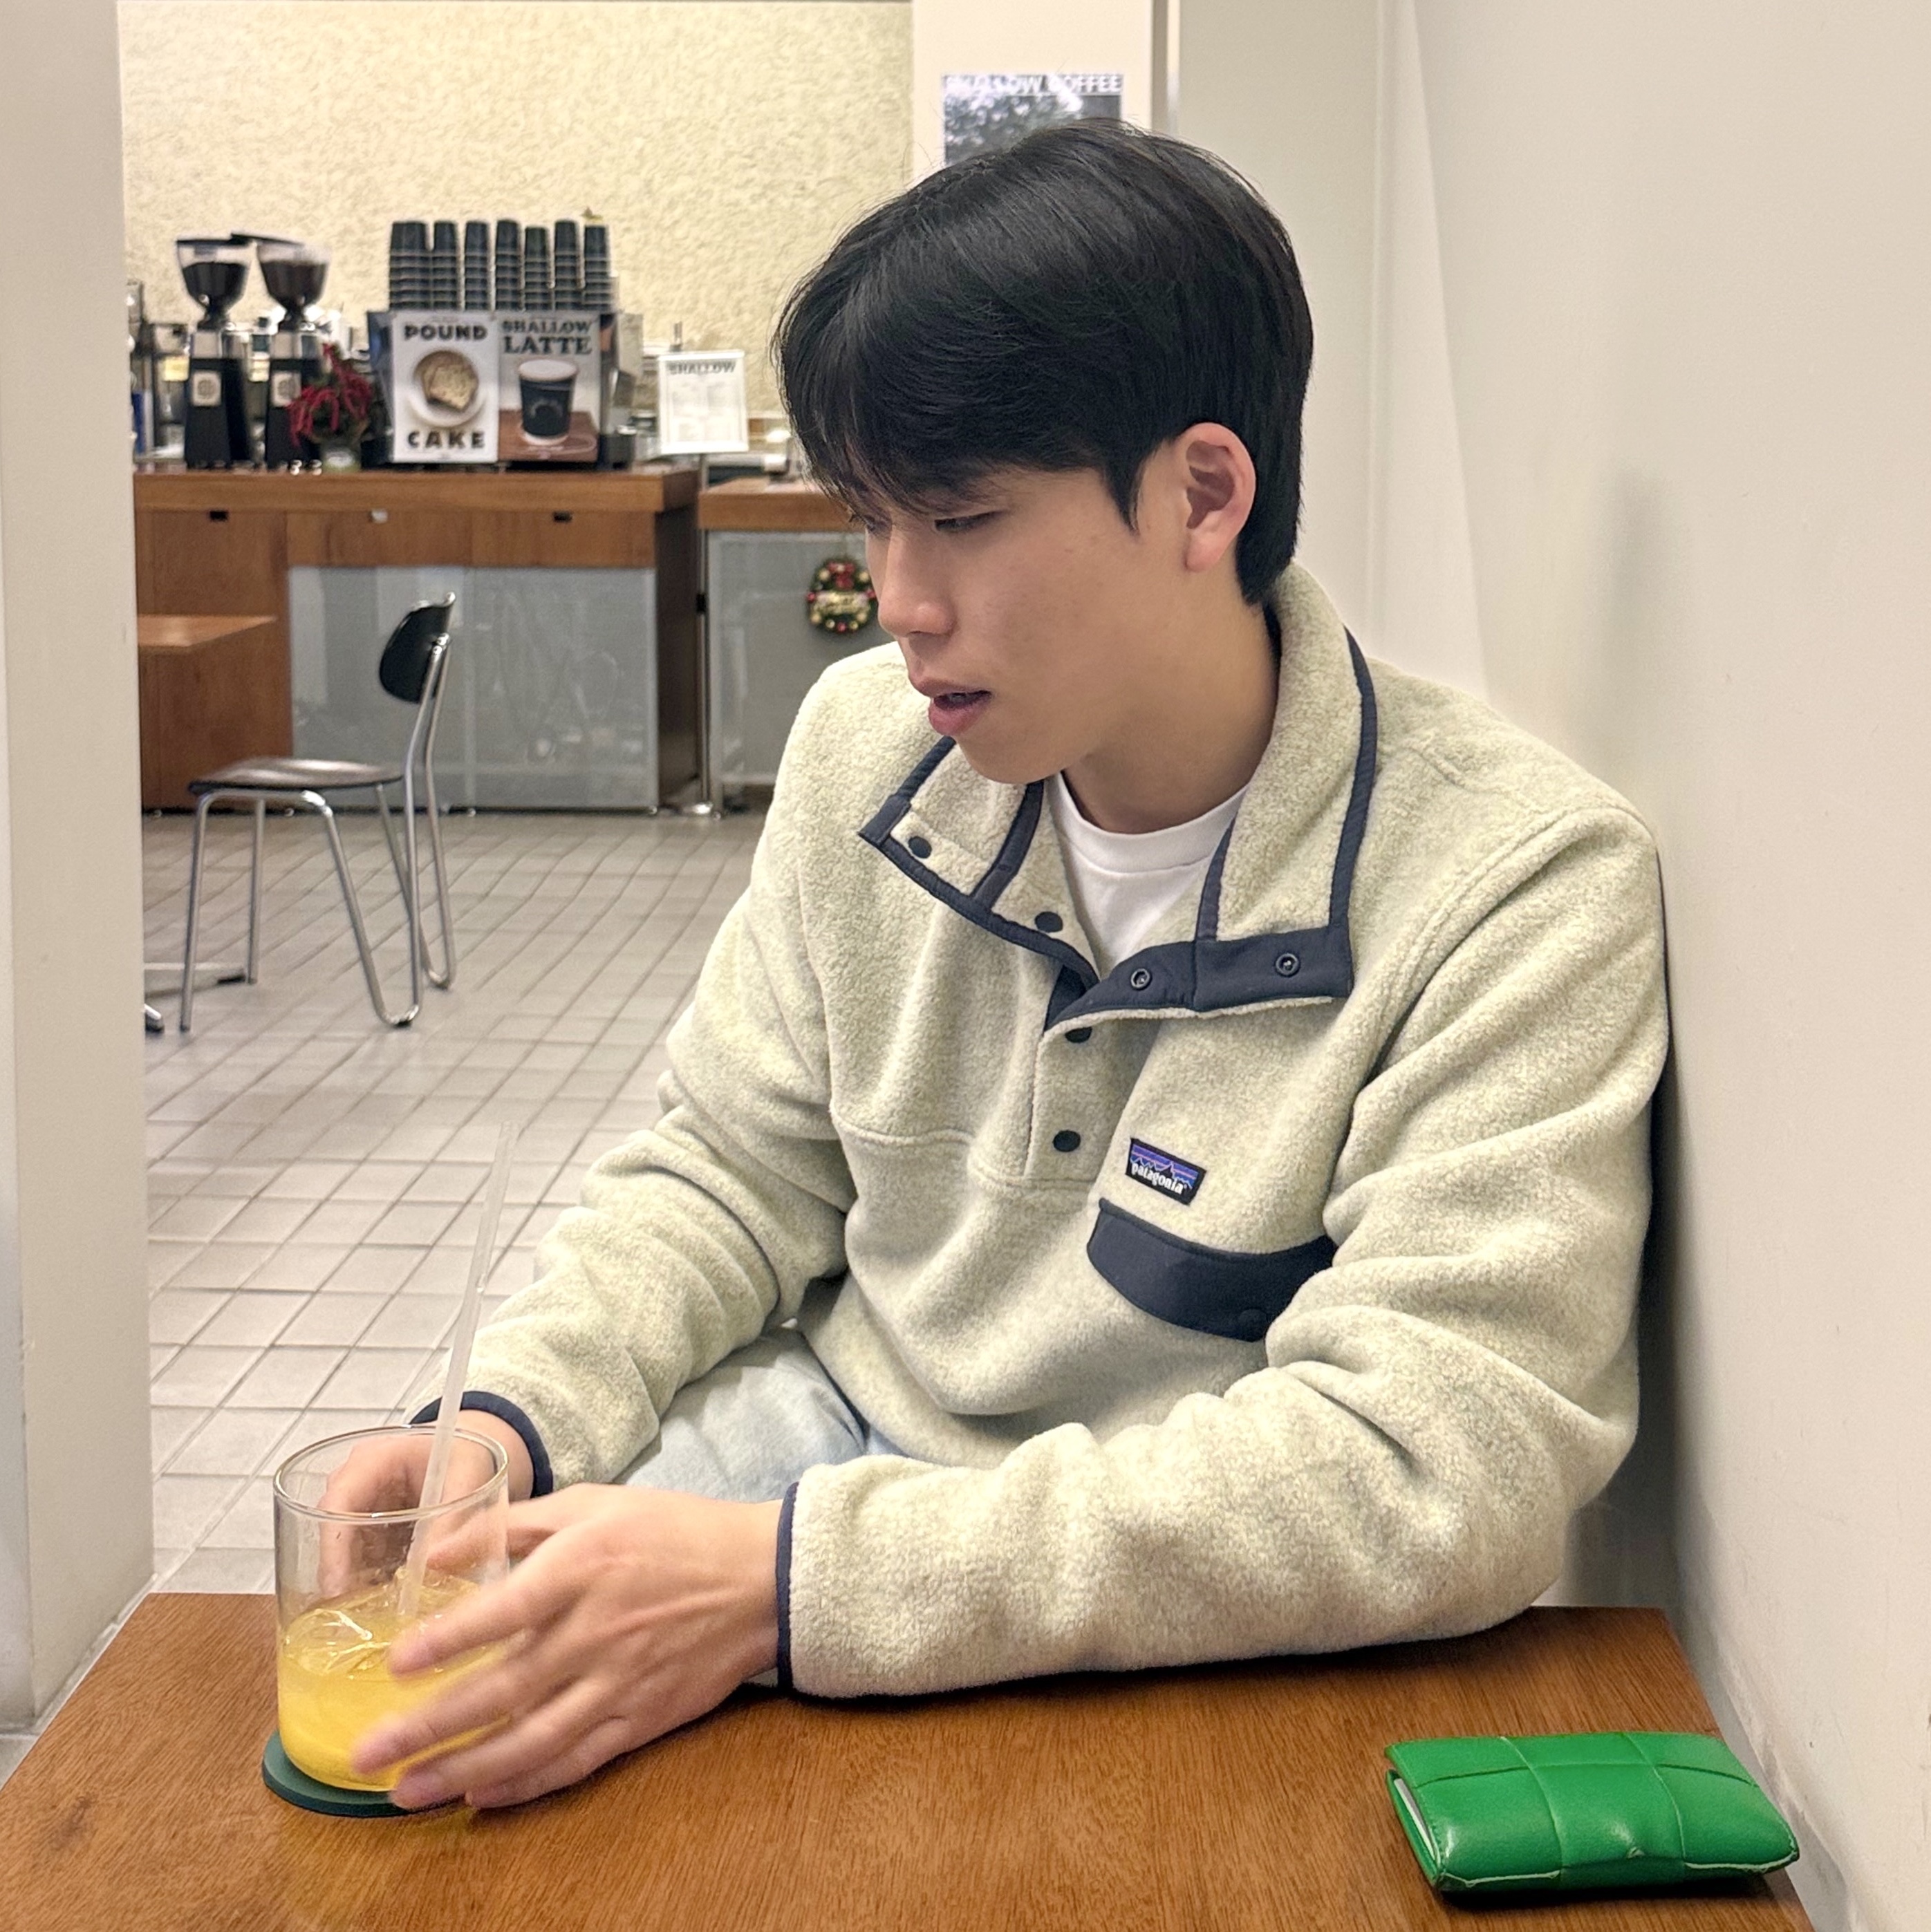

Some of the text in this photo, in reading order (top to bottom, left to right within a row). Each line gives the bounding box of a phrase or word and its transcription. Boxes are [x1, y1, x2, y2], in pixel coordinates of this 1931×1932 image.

[404, 324, 487, 340] POUND
[503, 320, 593, 333] SHALLOW
[504, 336, 593, 355] LATTE
[666, 360, 737, 375] SHALLOW
[408, 431, 486, 449] CAKE
[1131, 1163, 1184, 1194] patagonia
